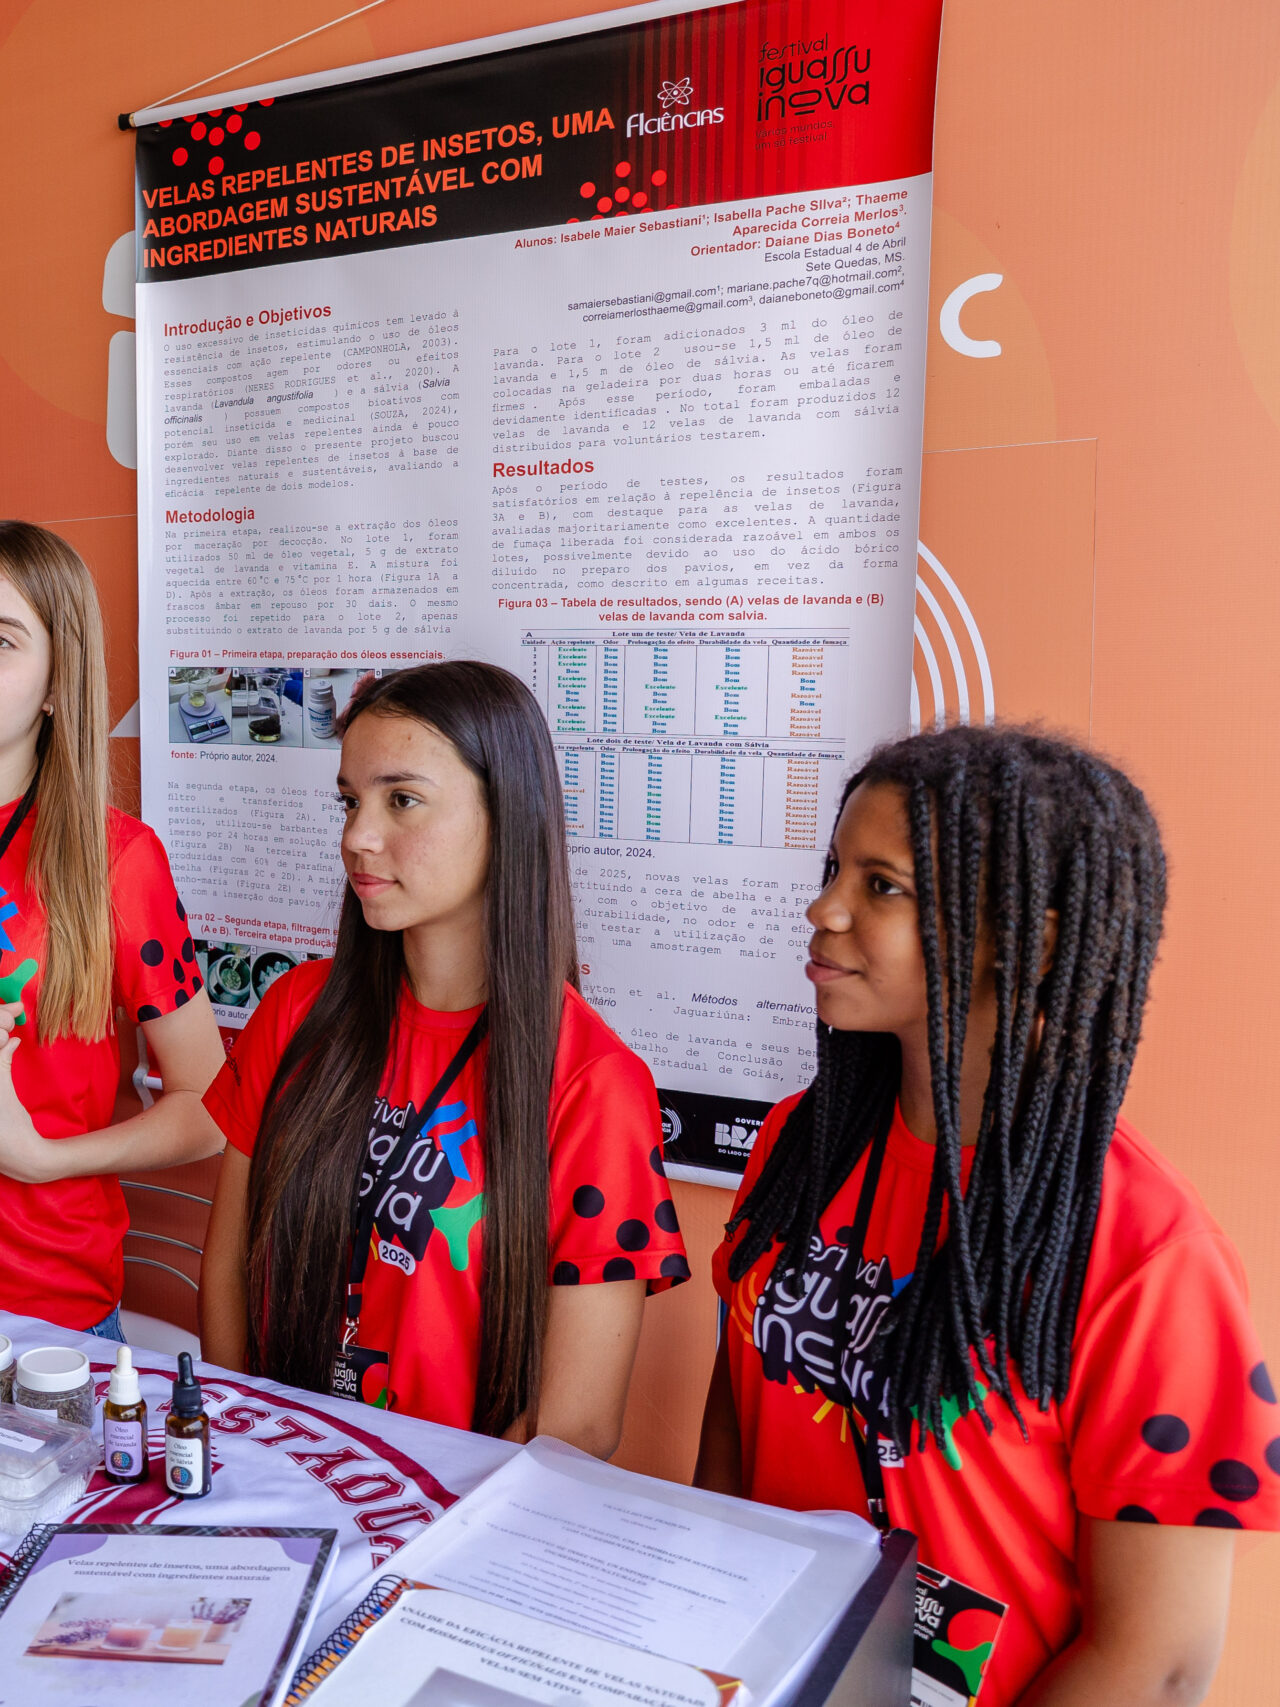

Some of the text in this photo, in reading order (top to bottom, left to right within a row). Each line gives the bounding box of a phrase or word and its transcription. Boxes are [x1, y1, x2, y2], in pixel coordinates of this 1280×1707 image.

[758, 33, 828, 63] festival
[756, 81, 870, 122] inova
[142, 108, 615, 209] VELAS REPELENTES DE INSETOS, UMA
[142, 154, 542, 239] ABORDAGEM SUSTENTÁVEL COM
[514, 236, 556, 248] Alunos:
[560, 229, 600, 242] Isabele
[604, 225, 635, 236] Maier
[714, 208, 761, 222] Isabella
[766, 203, 805, 216] Pache
[855, 190, 907, 205] Thaeme
[732, 219, 796, 237] Aparecida
[801, 213, 849, 227] Correia
[141, 205, 437, 269] INGREDIENTES NATURAIS
[690, 240, 760, 256] Orientador:
[765, 235, 809, 247] Daiane
[814, 231, 842, 242] Dias
[764, 236, 906, 262] Escola Estadual 4 de Abril
[805, 251, 904, 271] Sete Quedas, MS.
[164, 306, 331, 336] Introdução e Objetivos
[578, 439, 605, 450] para
[699, 430, 765, 440] testarem.
[493, 459, 594, 477] Resultados
[165, 507, 254, 523] Metodologia
[498, 593, 883, 610] Figura 03 Tabela de resultados, sendo (A) velas de lavanda e (B)
[598, 610, 767, 621] velas de lavanda com salvia.
[612, 630, 630, 638] Lote
[645, 630, 654, 638] de
[679, 630, 697, 638] Vela
[698, 630, 709, 638] de
[711, 630, 746, 638] Lavanda
[169, 649, 446, 662] Figura 01 Primeira etapa, preparação dos óleos essenciais.
[170, 750, 277, 762] fonte: Próprio autor, 2024.
[593, 845, 656, 858] autor, 2024.
[691, 993, 818, 1015] Métodos alternativos
[381, 1245, 411, 1269] 2025
[95, 1560, 148, 1568] repelentes
[163, 1562, 203, 1570] insetos,
[230, 1564, 291, 1572] abordagem
[158, 1572, 223, 1580] ingredientes
[605, 1673, 642, 1689] VELAS
